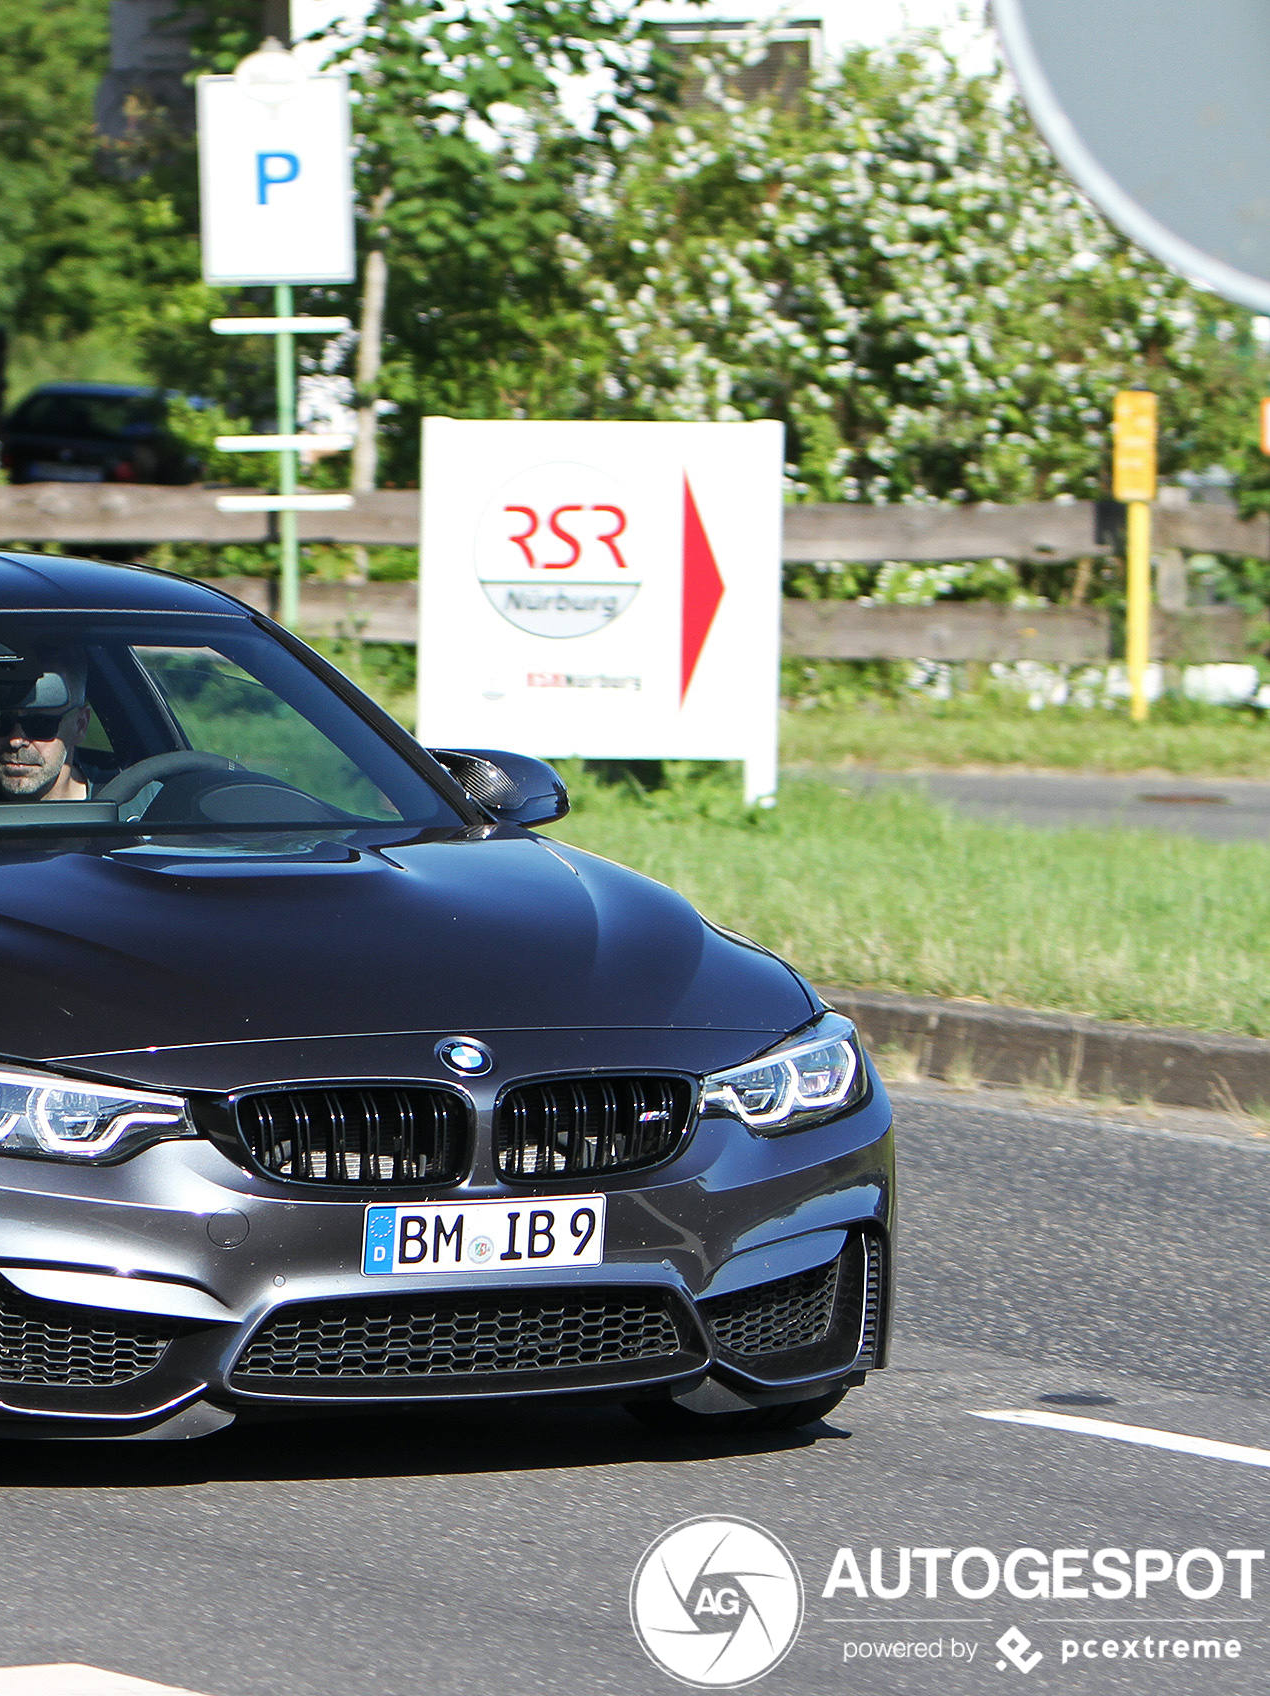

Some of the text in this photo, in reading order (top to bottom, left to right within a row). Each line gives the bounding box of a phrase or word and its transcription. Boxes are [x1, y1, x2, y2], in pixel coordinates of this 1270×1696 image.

[255, 150, 301, 206] P
[503, 504, 629, 569] RSR
[373, 1246, 386, 1262] D
[398, 1207, 597, 1264] BM IB 9
